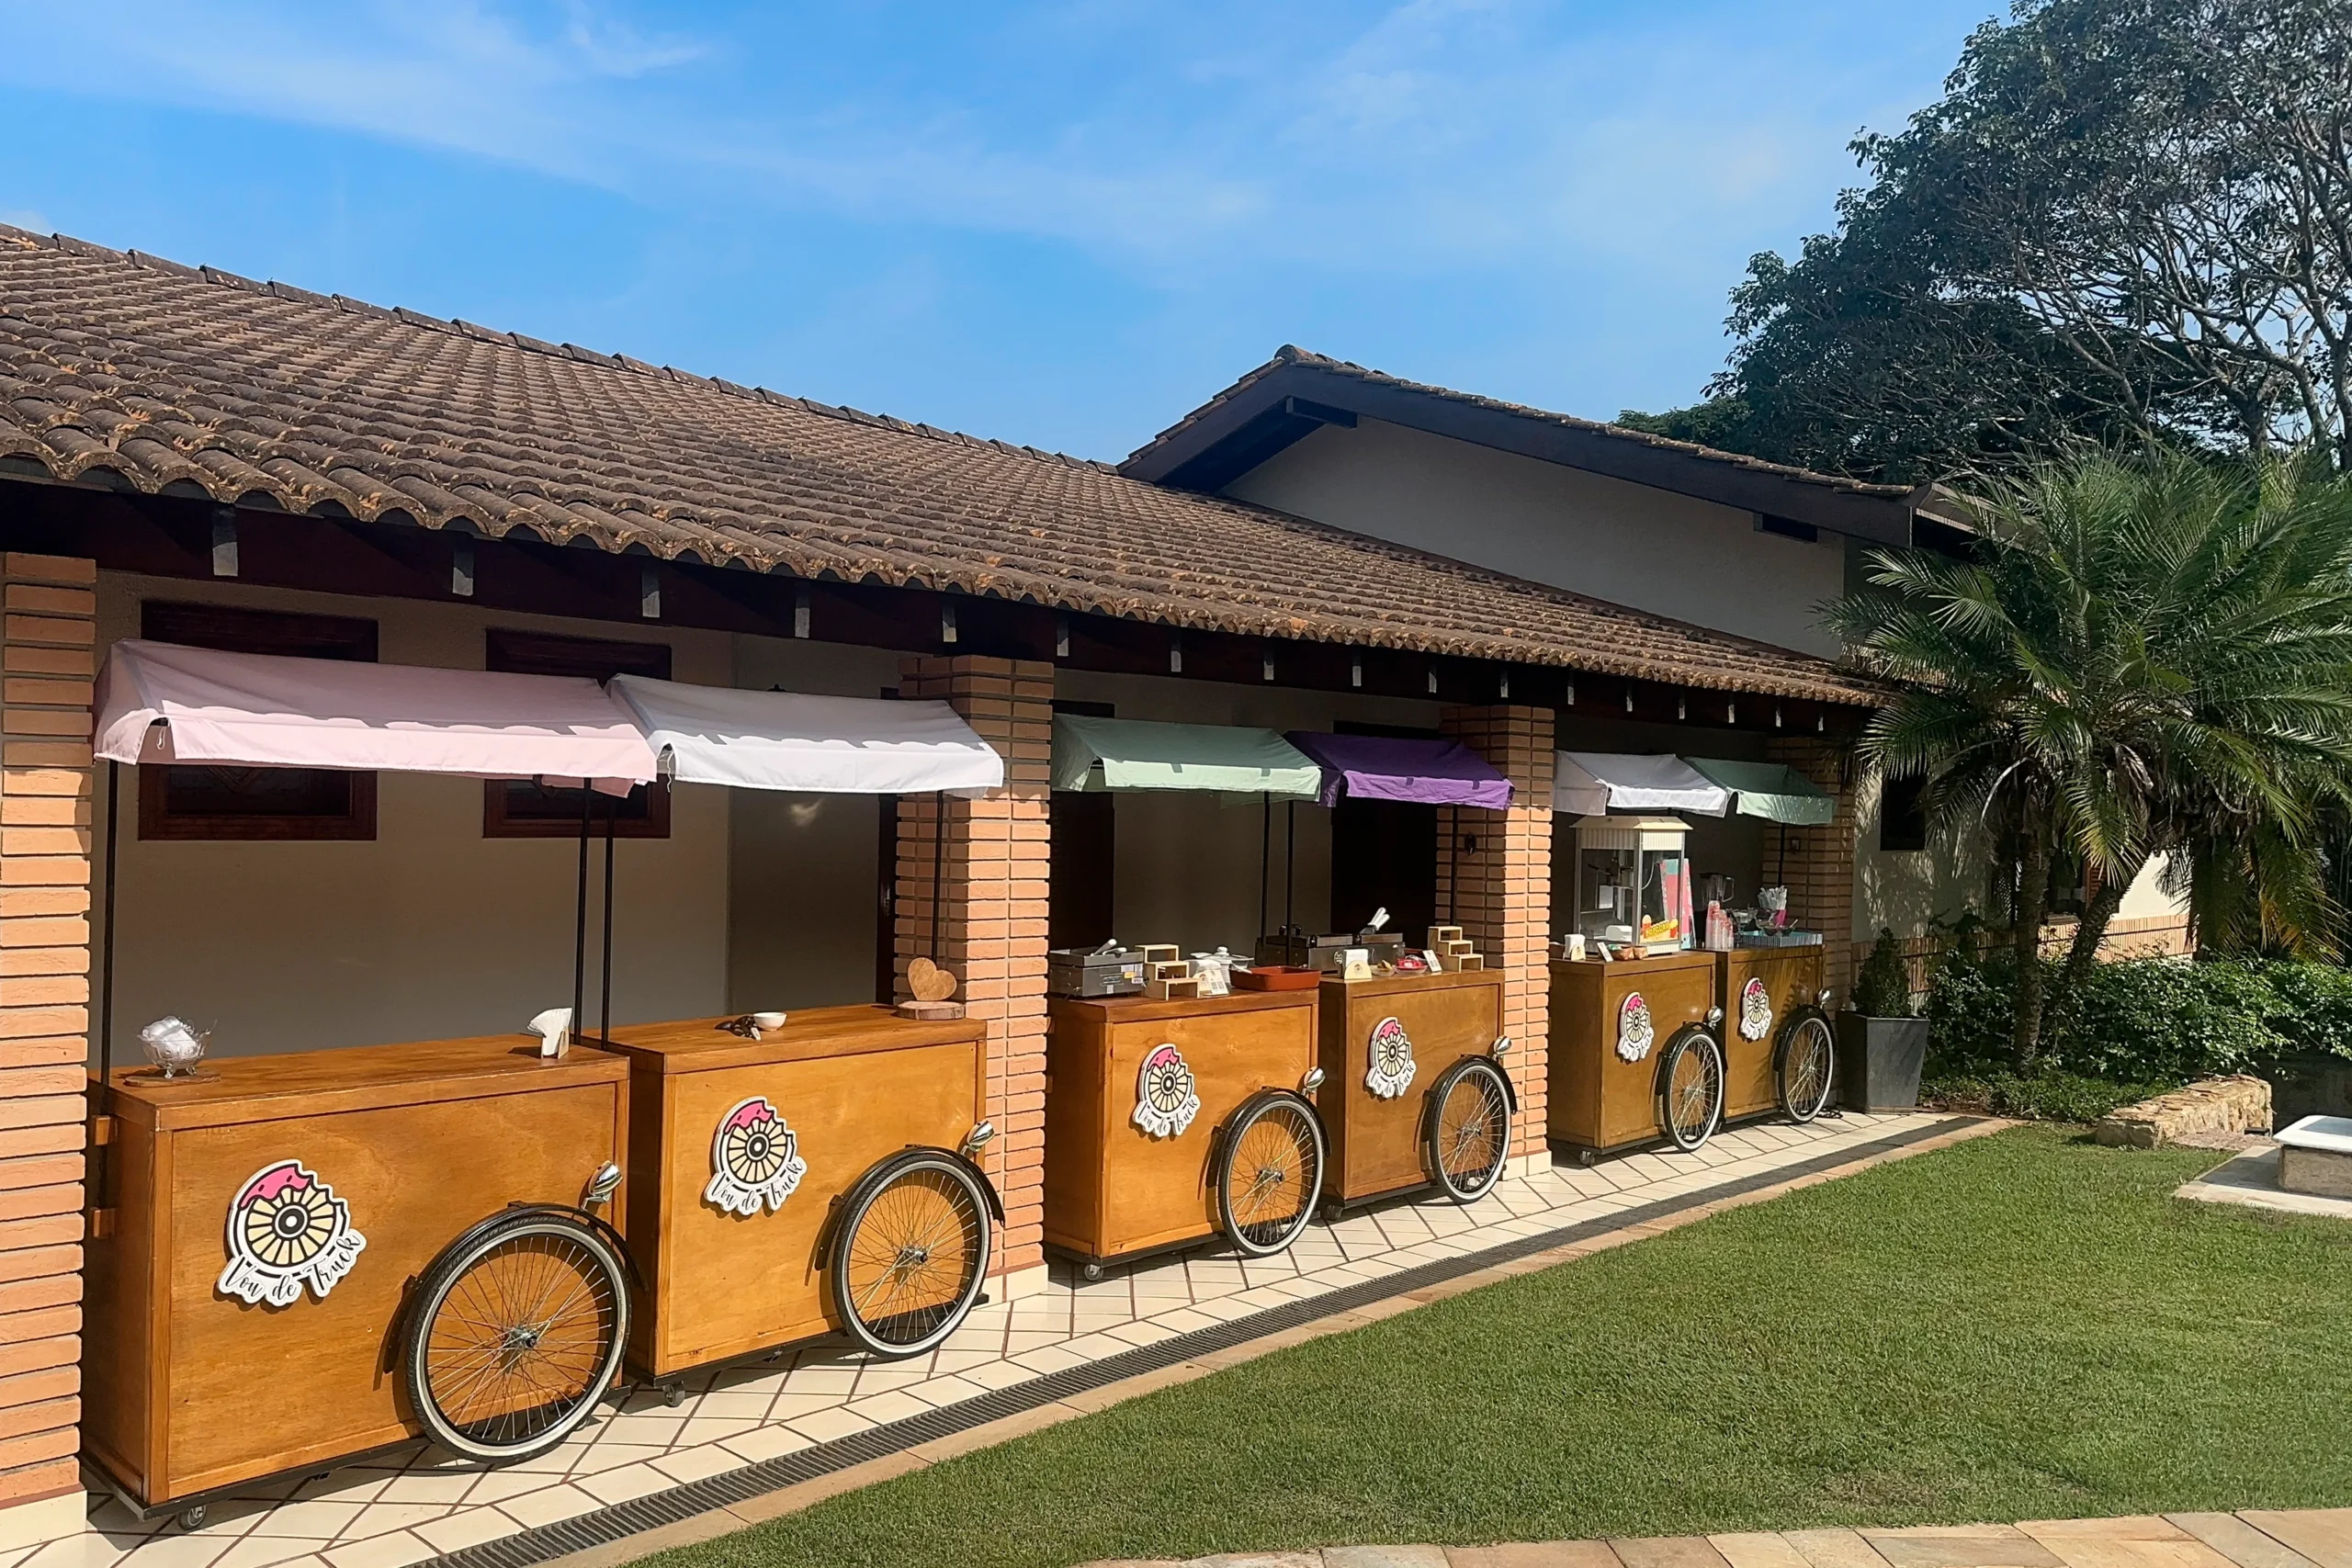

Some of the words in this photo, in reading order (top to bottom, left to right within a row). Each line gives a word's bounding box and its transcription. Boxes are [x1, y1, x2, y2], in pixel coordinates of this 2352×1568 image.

[710, 1172, 736, 1206] Vou
[741, 1190, 758, 1210] de
[763, 1161, 803, 1205] Truck
[225, 1256, 262, 1297] Vou
[272, 1275, 297, 1300] de
[301, 1235, 360, 1291] Truck
